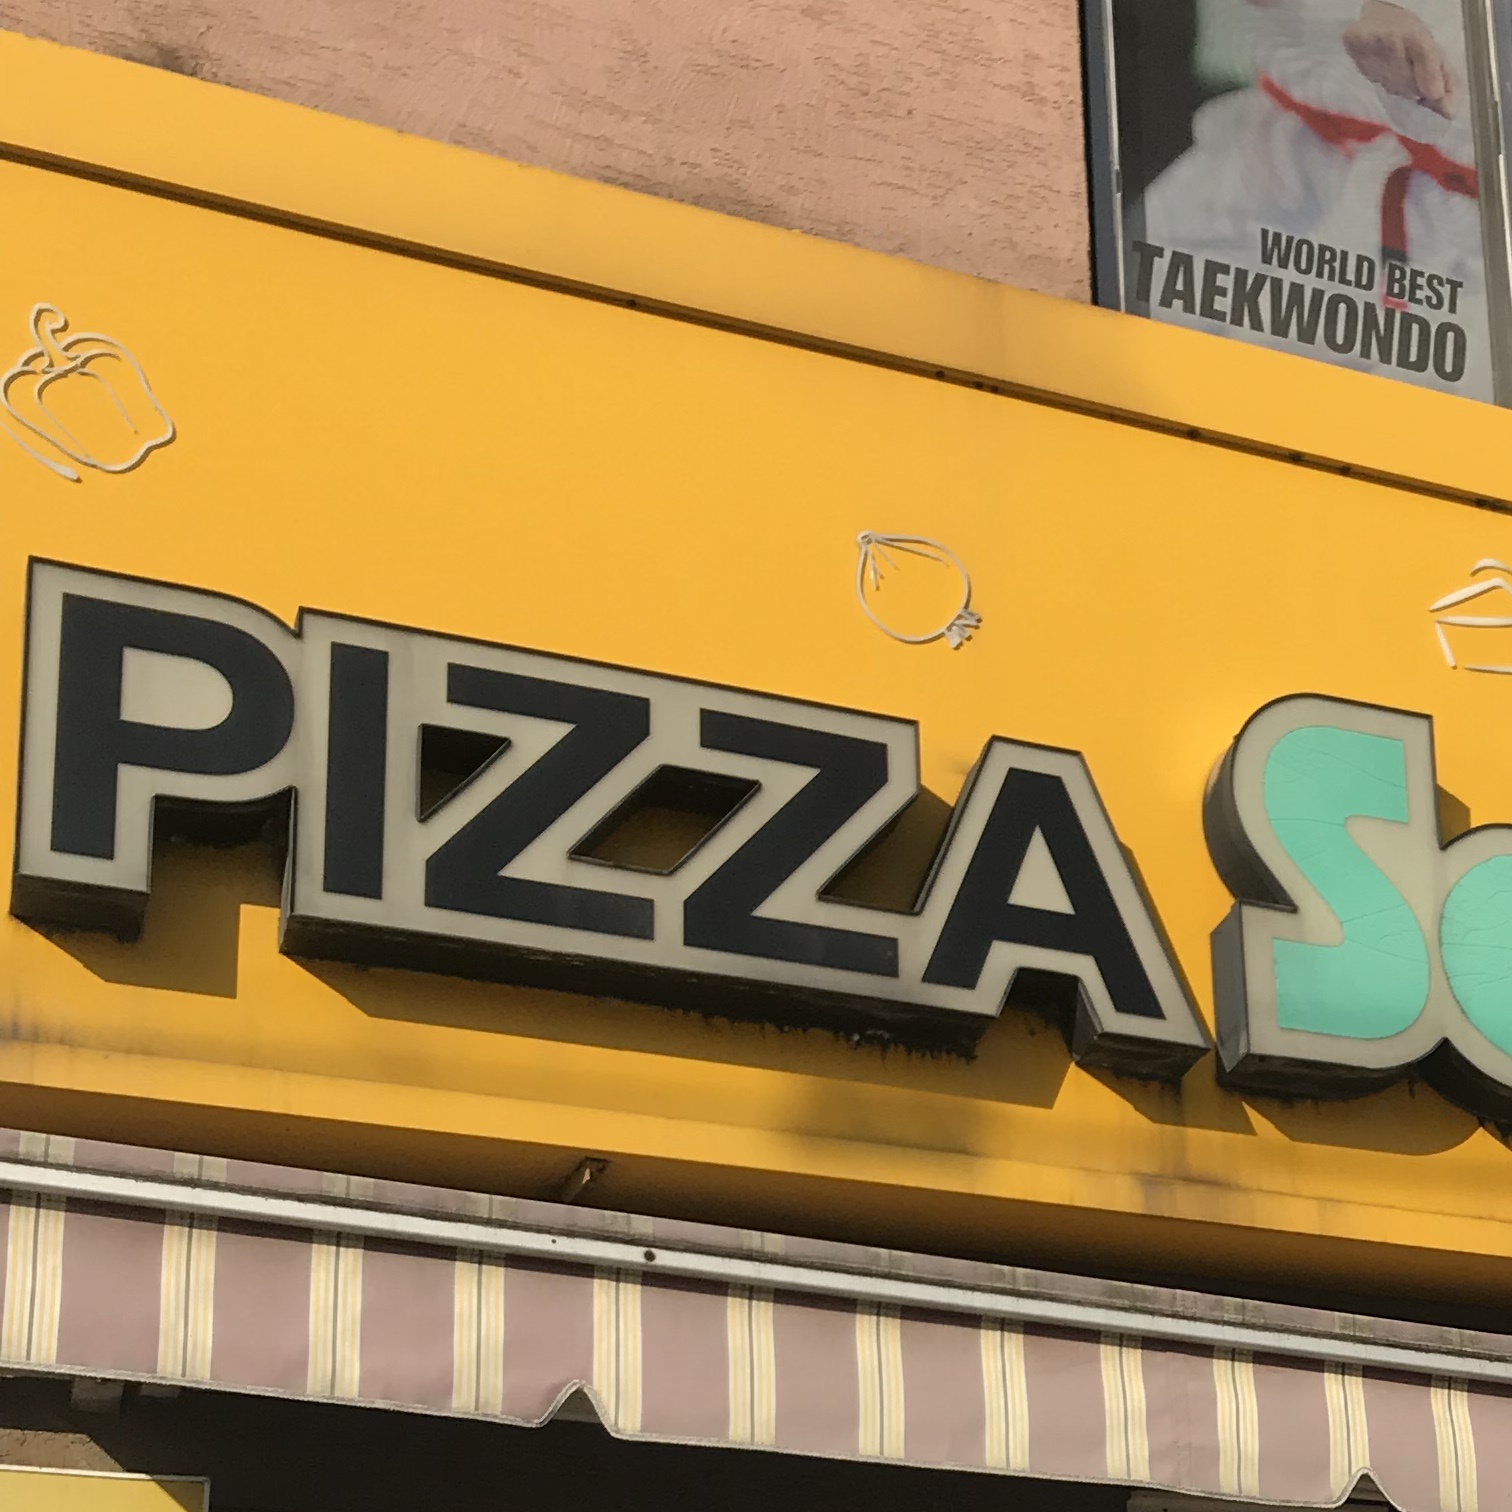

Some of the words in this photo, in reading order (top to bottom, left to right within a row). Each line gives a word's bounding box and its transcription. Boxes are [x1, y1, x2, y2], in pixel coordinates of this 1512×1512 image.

[1132, 240, 1467, 383] TAEKWONDO
[1260, 227, 1377, 291] WORLD
[1386, 259, 1464, 314] BEST
[50, 592, 1168, 1021] PIZZA
